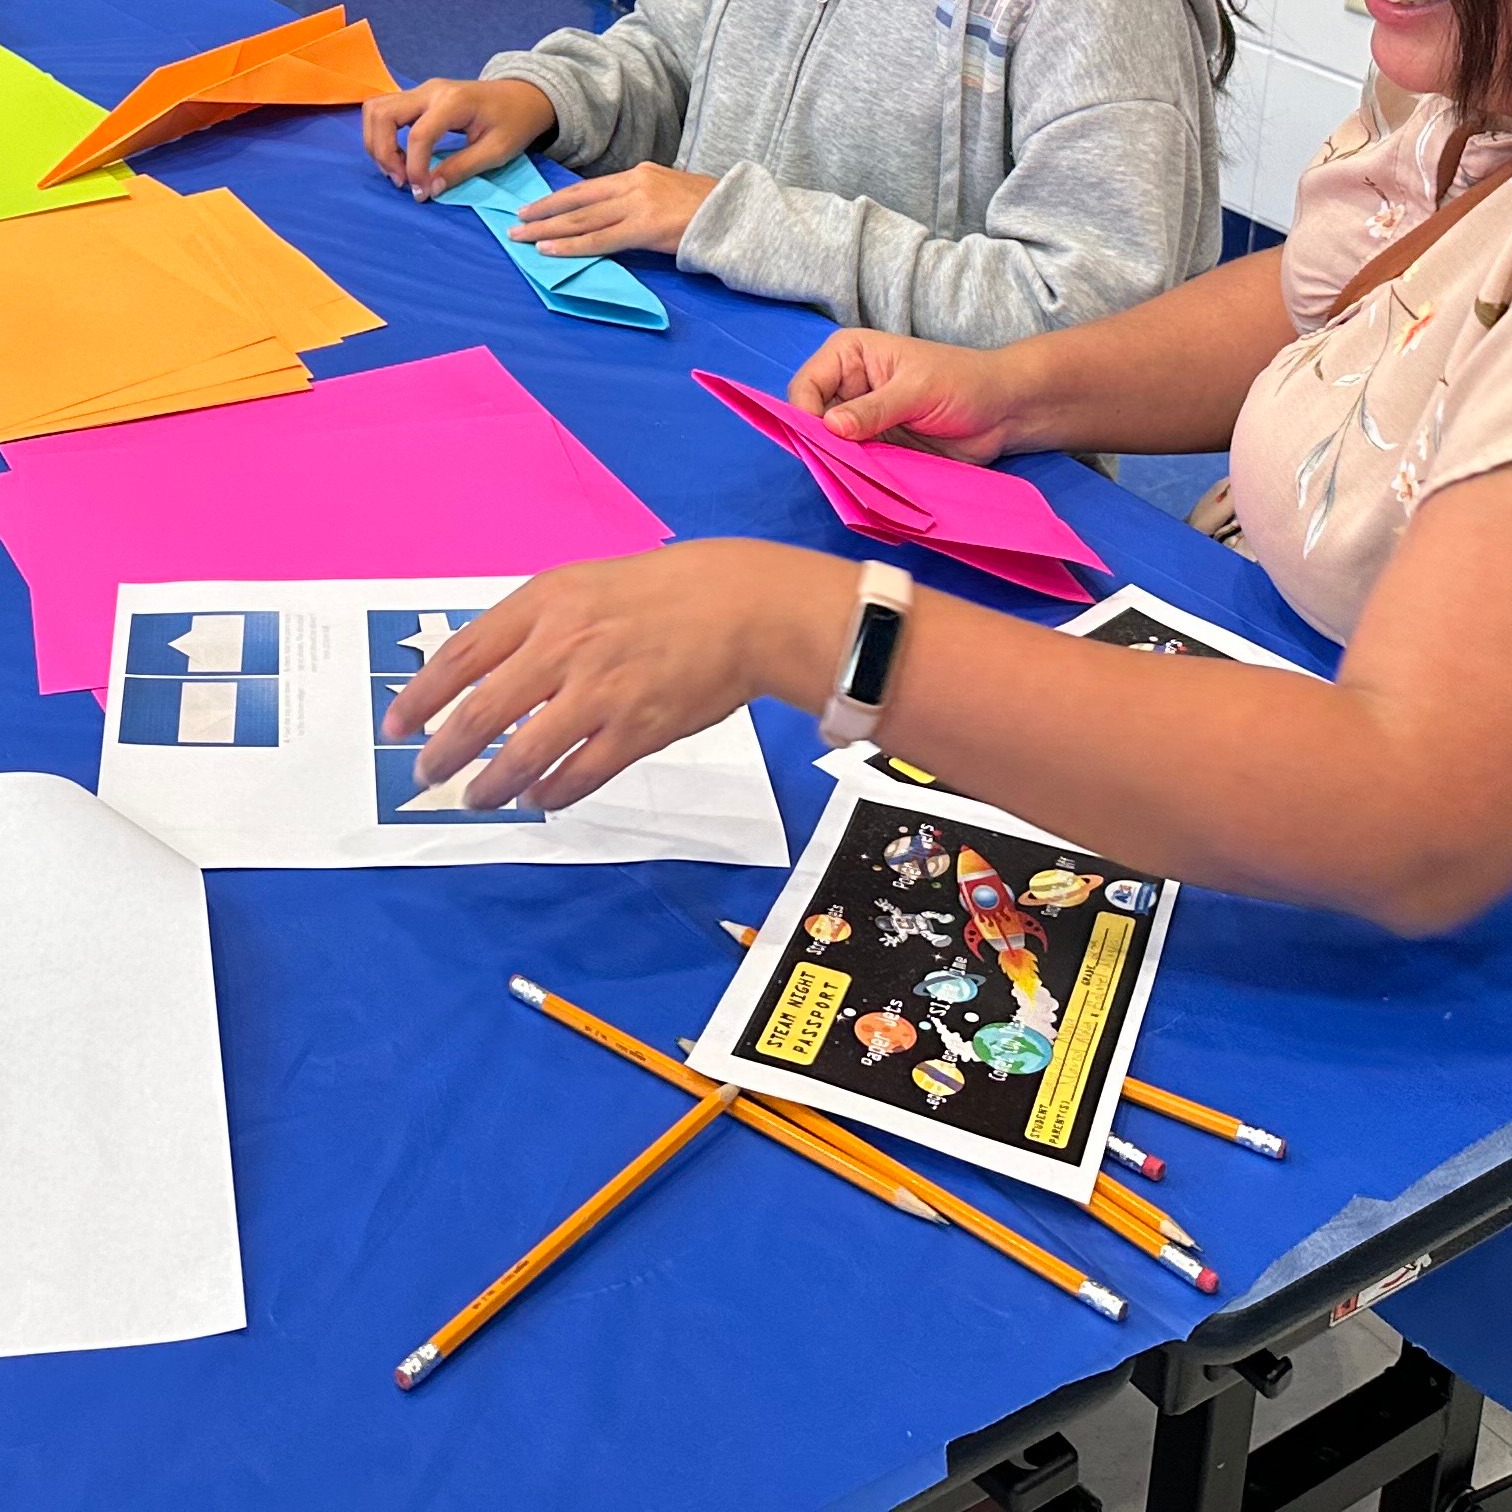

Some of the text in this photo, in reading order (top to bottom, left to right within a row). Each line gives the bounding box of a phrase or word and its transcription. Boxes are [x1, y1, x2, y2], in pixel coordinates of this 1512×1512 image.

[767, 970, 816, 1048] STEAM NIGHT
[792, 981, 838, 1055] PASSPORT
[881, 999, 903, 1029] Jets
[1030, 1104, 1050, 1138] STUDENT
